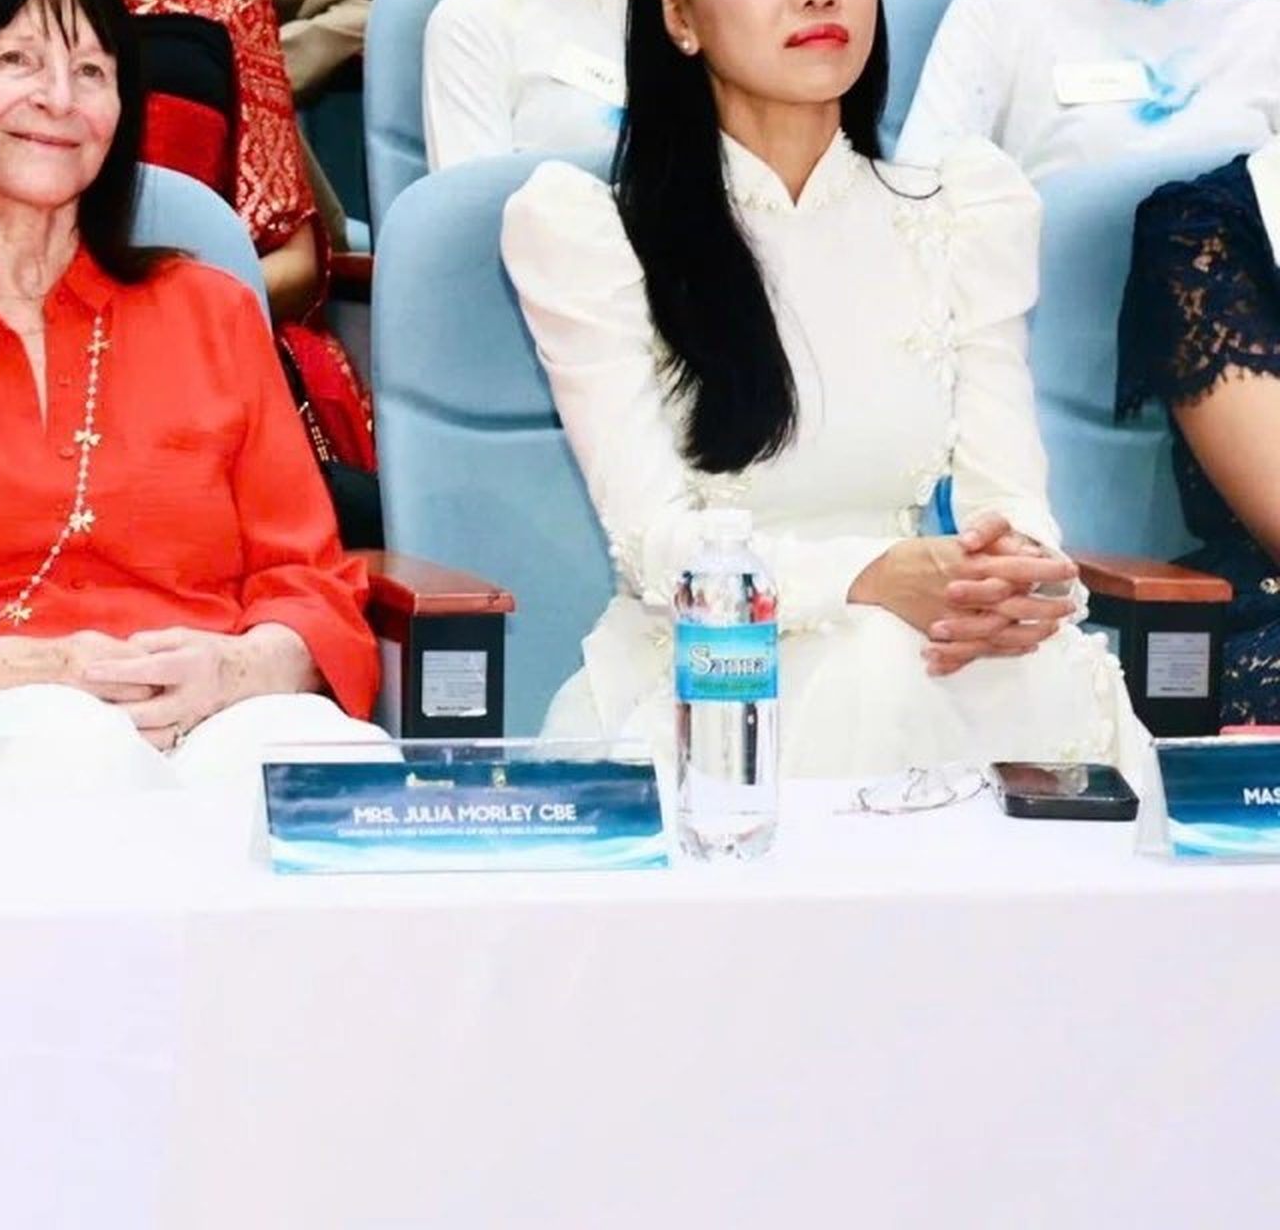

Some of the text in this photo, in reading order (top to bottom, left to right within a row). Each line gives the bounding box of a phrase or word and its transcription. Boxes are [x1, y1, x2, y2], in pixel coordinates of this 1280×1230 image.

[353, 803, 577, 825] MRS. JULIA MORLEY CBE
